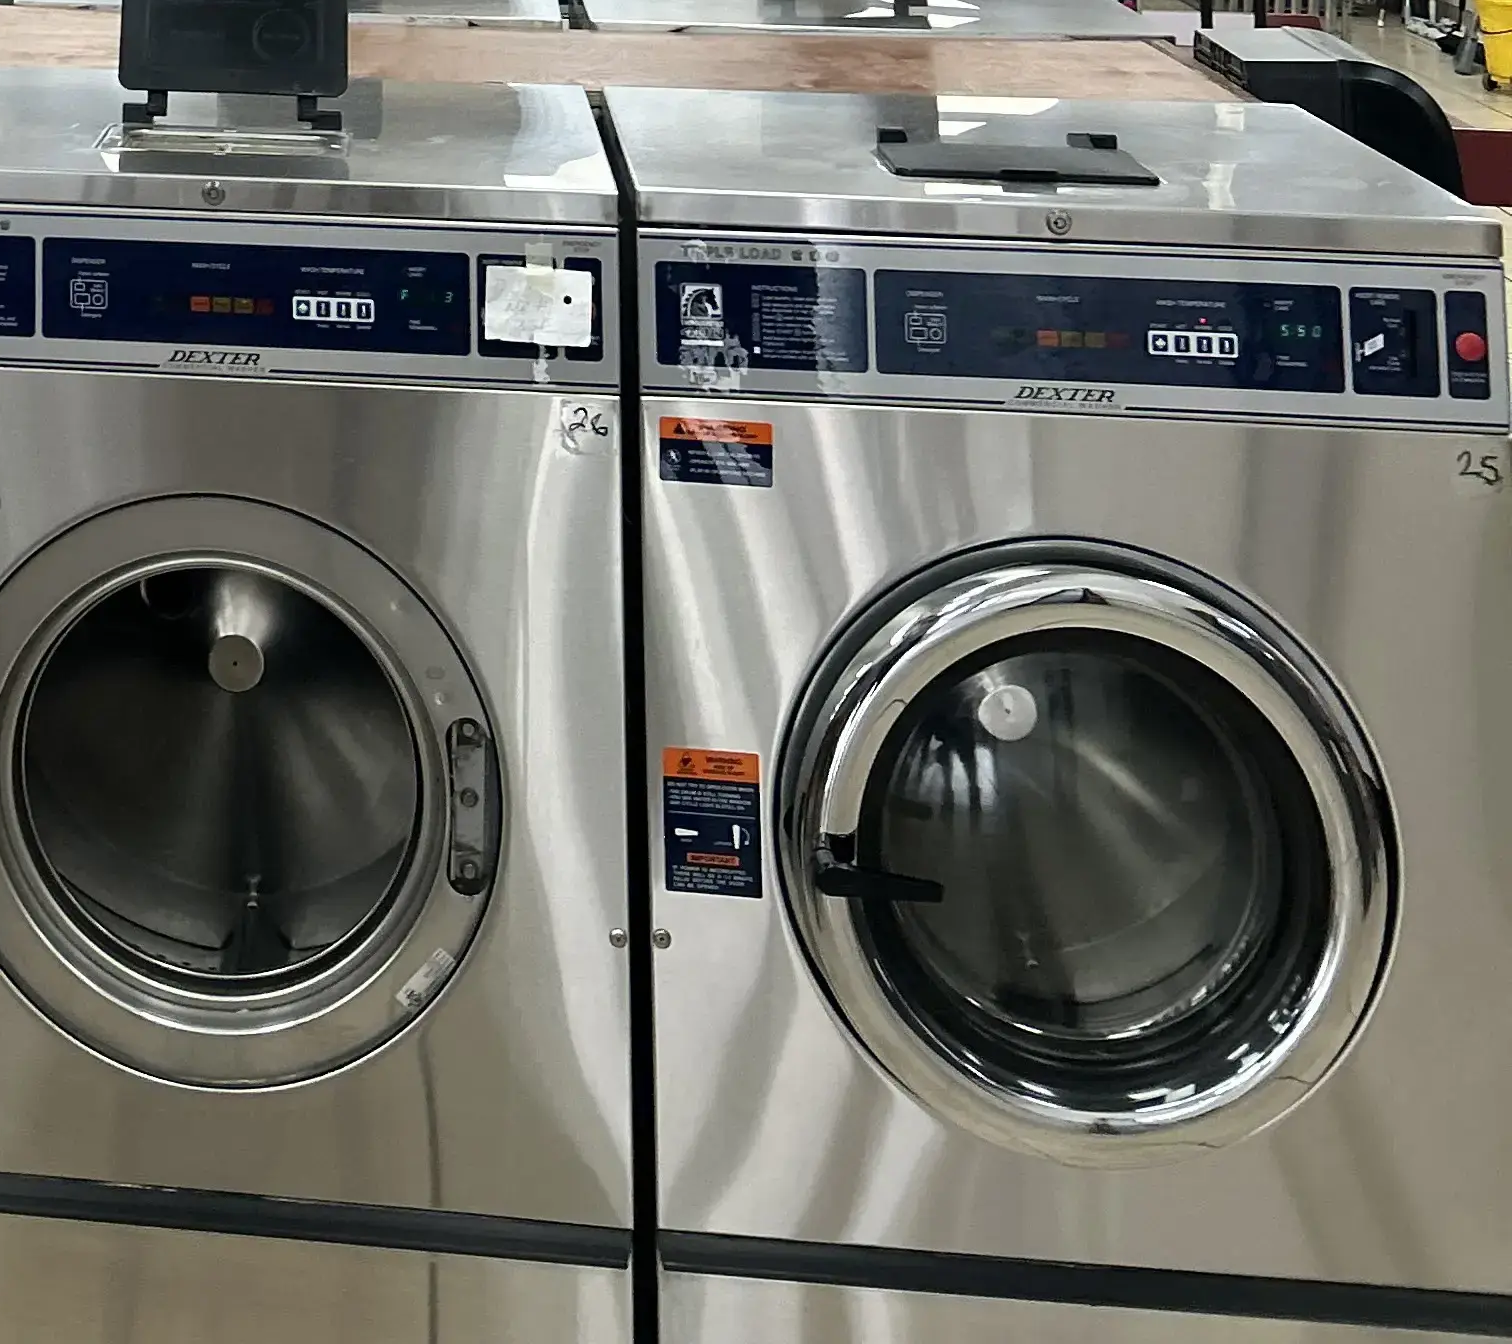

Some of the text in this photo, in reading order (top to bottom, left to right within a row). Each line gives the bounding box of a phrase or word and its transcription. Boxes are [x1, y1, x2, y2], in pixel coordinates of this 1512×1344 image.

[740, 247, 781, 260] LOAD
[168, 349, 261, 366] DEXTER
[1015, 386, 1116, 402] DEXTER
[569, 406, 609, 437] 26
[1456, 450, 1504, 486] 25
